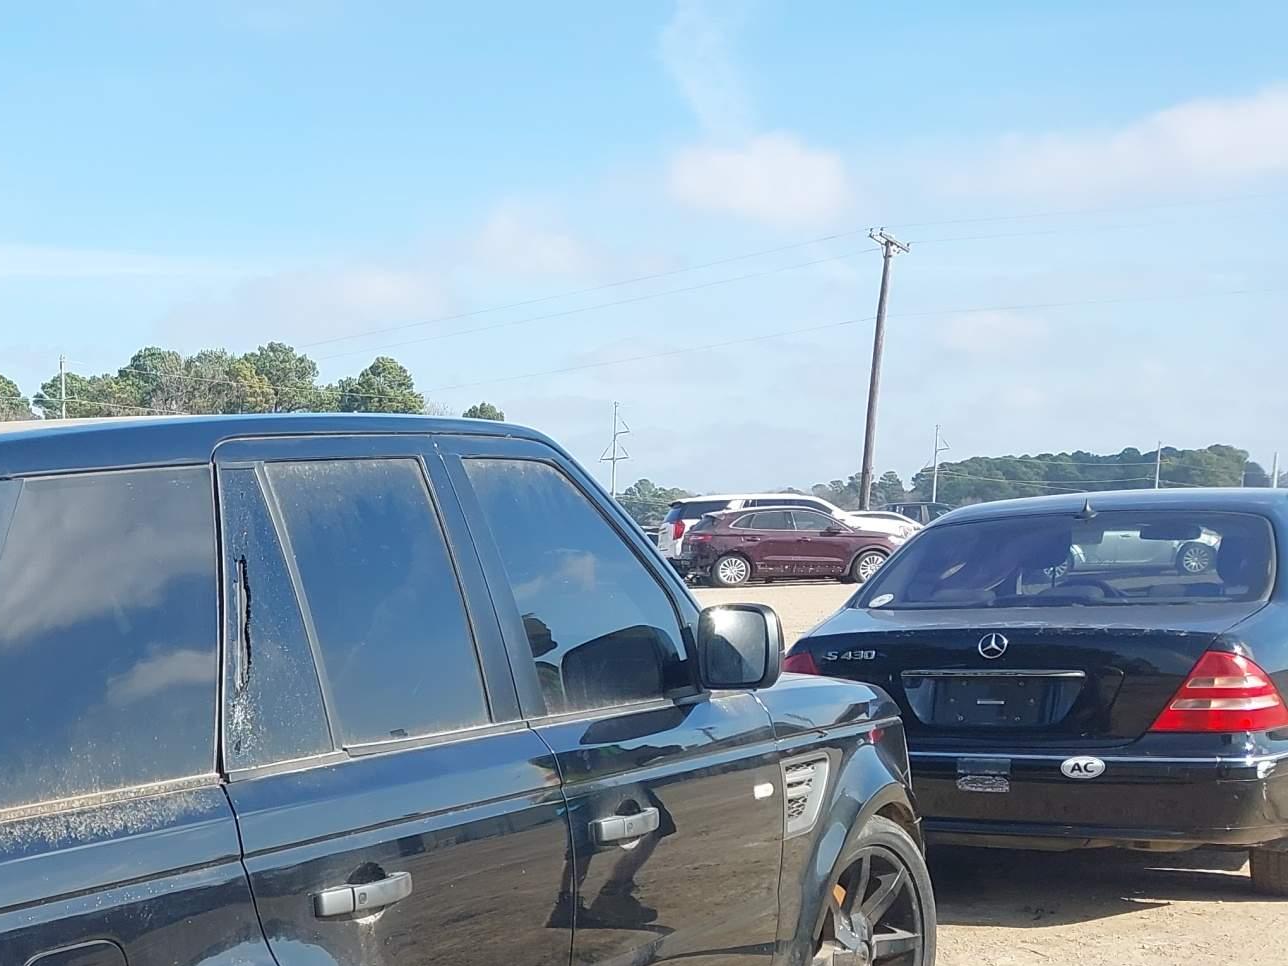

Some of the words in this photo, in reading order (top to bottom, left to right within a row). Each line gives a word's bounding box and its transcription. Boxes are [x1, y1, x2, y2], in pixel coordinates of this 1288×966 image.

[822, 651, 839, 661] S
[840, 650, 876, 660] 430
[1070, 762, 1095, 774] AC
